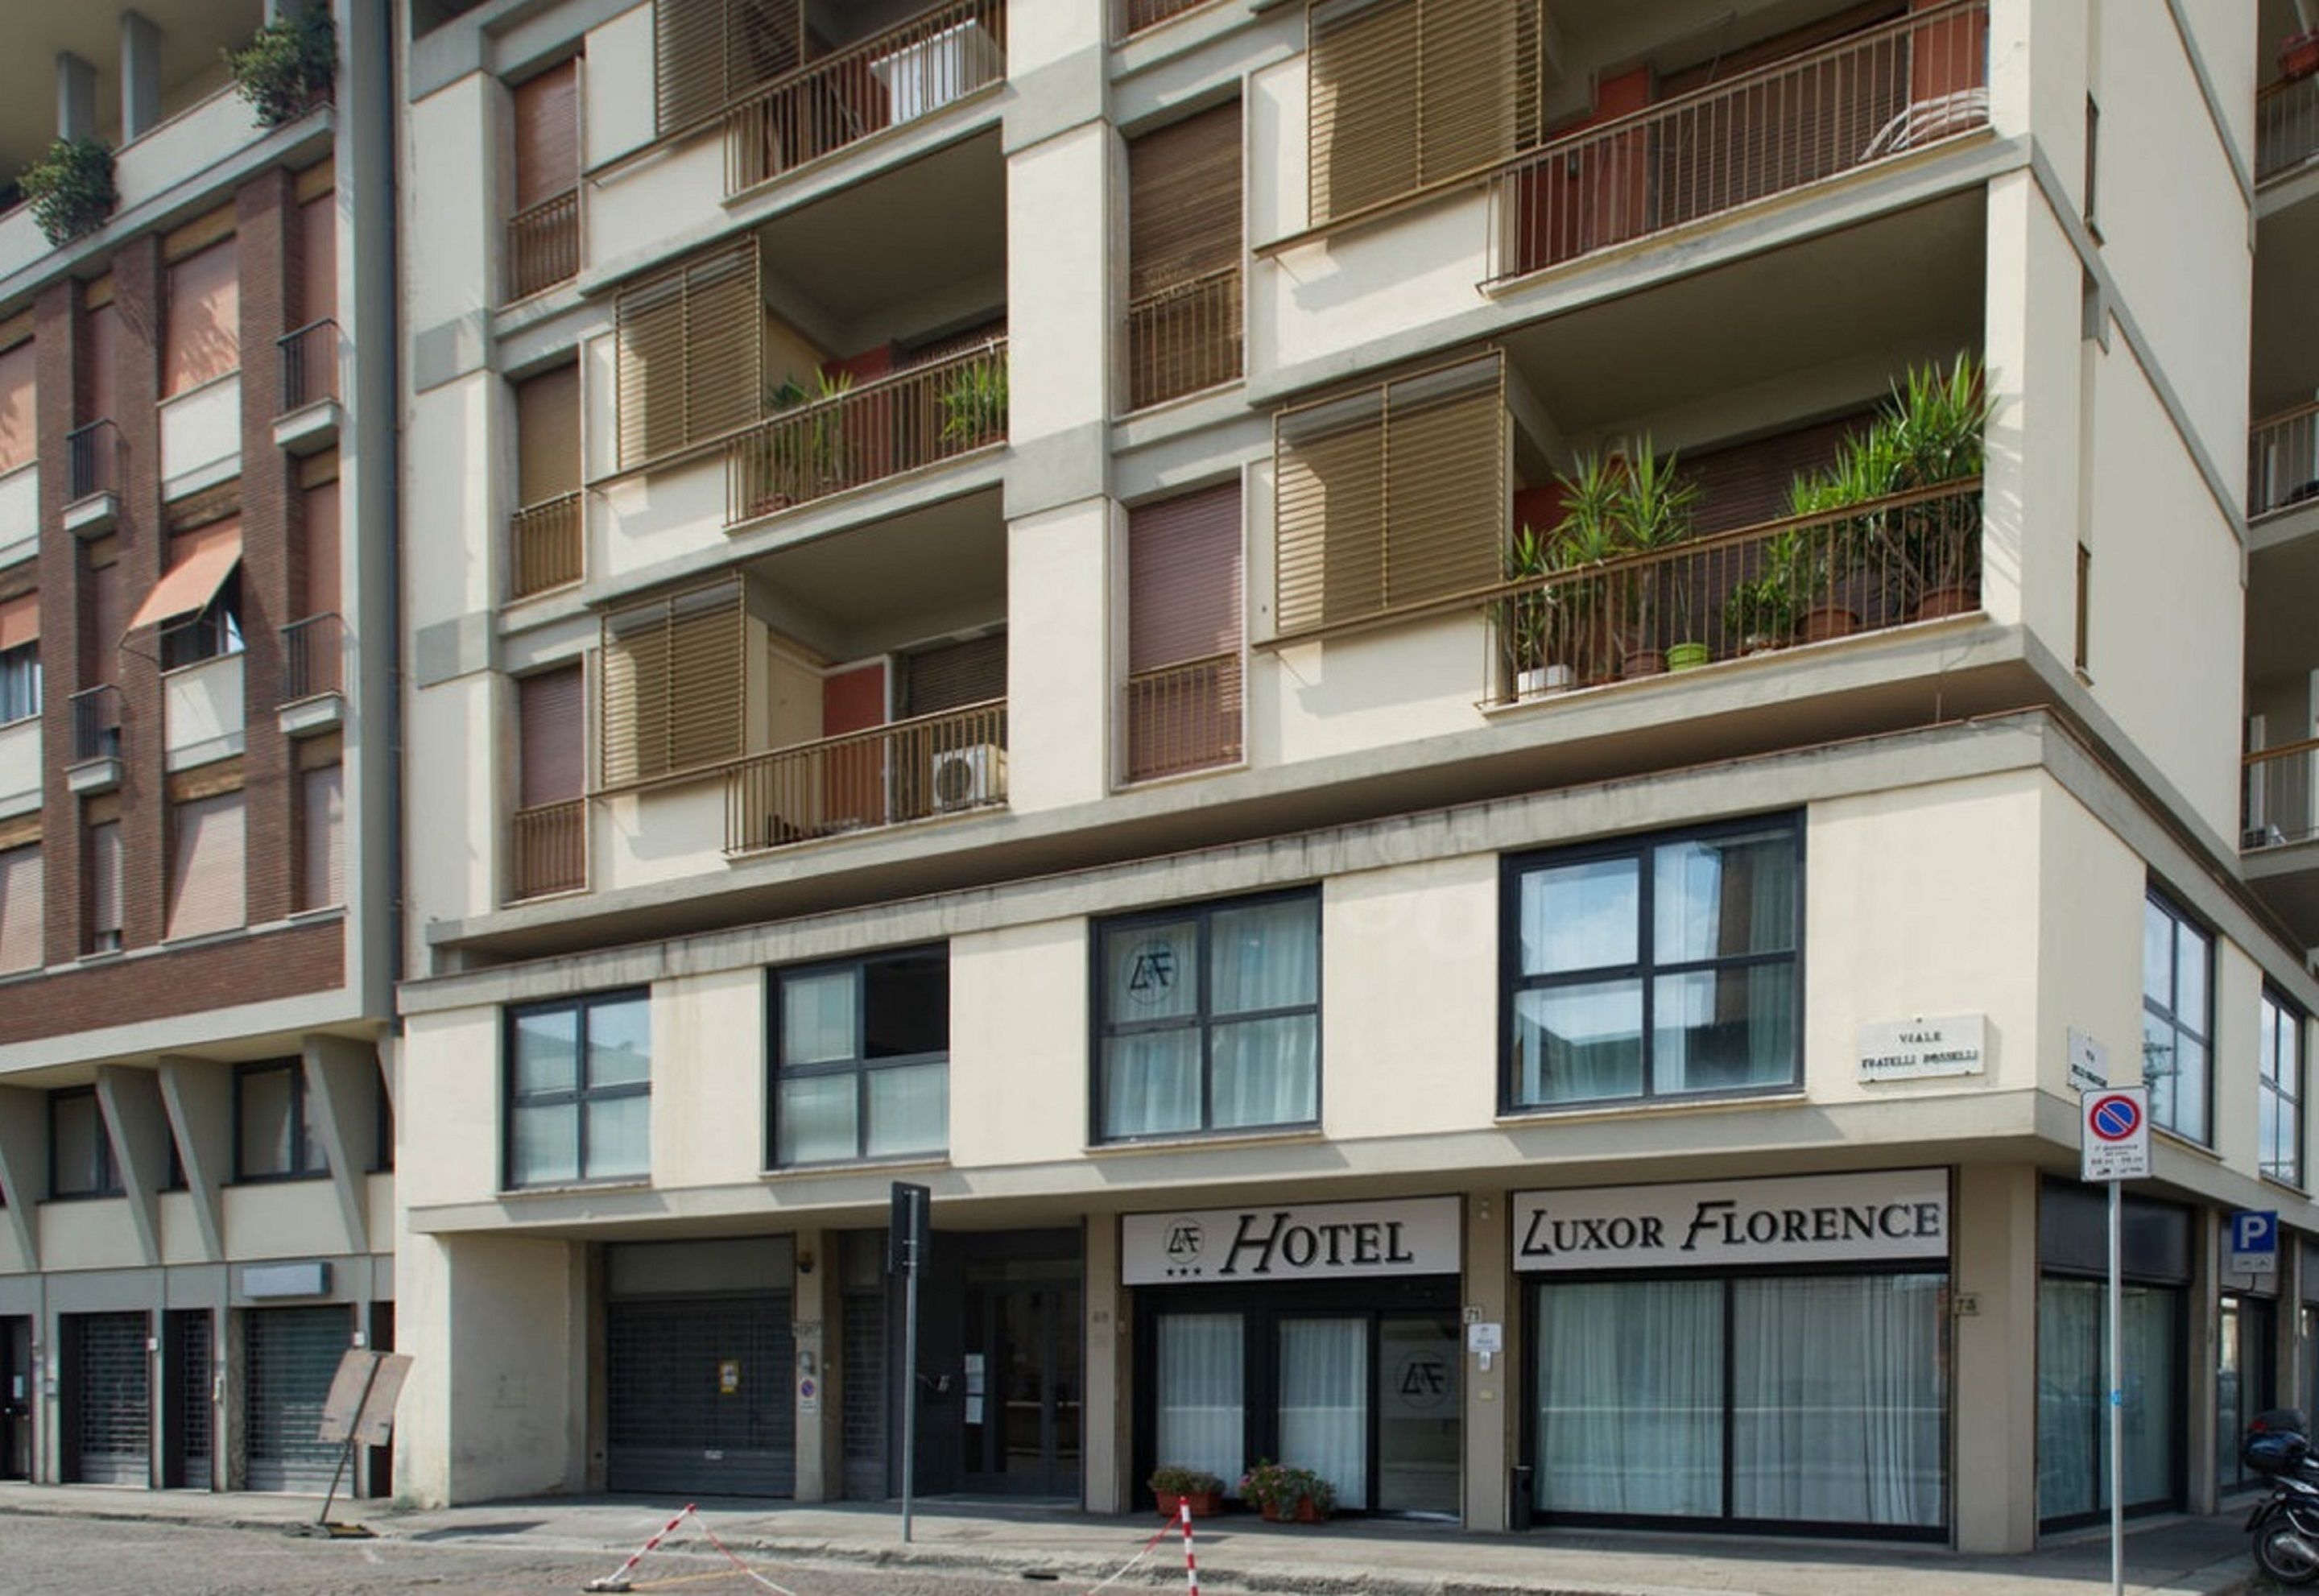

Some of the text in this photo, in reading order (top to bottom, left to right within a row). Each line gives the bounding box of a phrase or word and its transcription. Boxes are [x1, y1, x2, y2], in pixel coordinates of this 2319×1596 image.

[1899, 1032, 1941, 1043] VIALE
[1219, 1213, 1414, 1275] HOTEL
[1520, 1201, 1939, 1255] LUXOR FLORENCE
[2240, 1216, 2267, 1249] P
